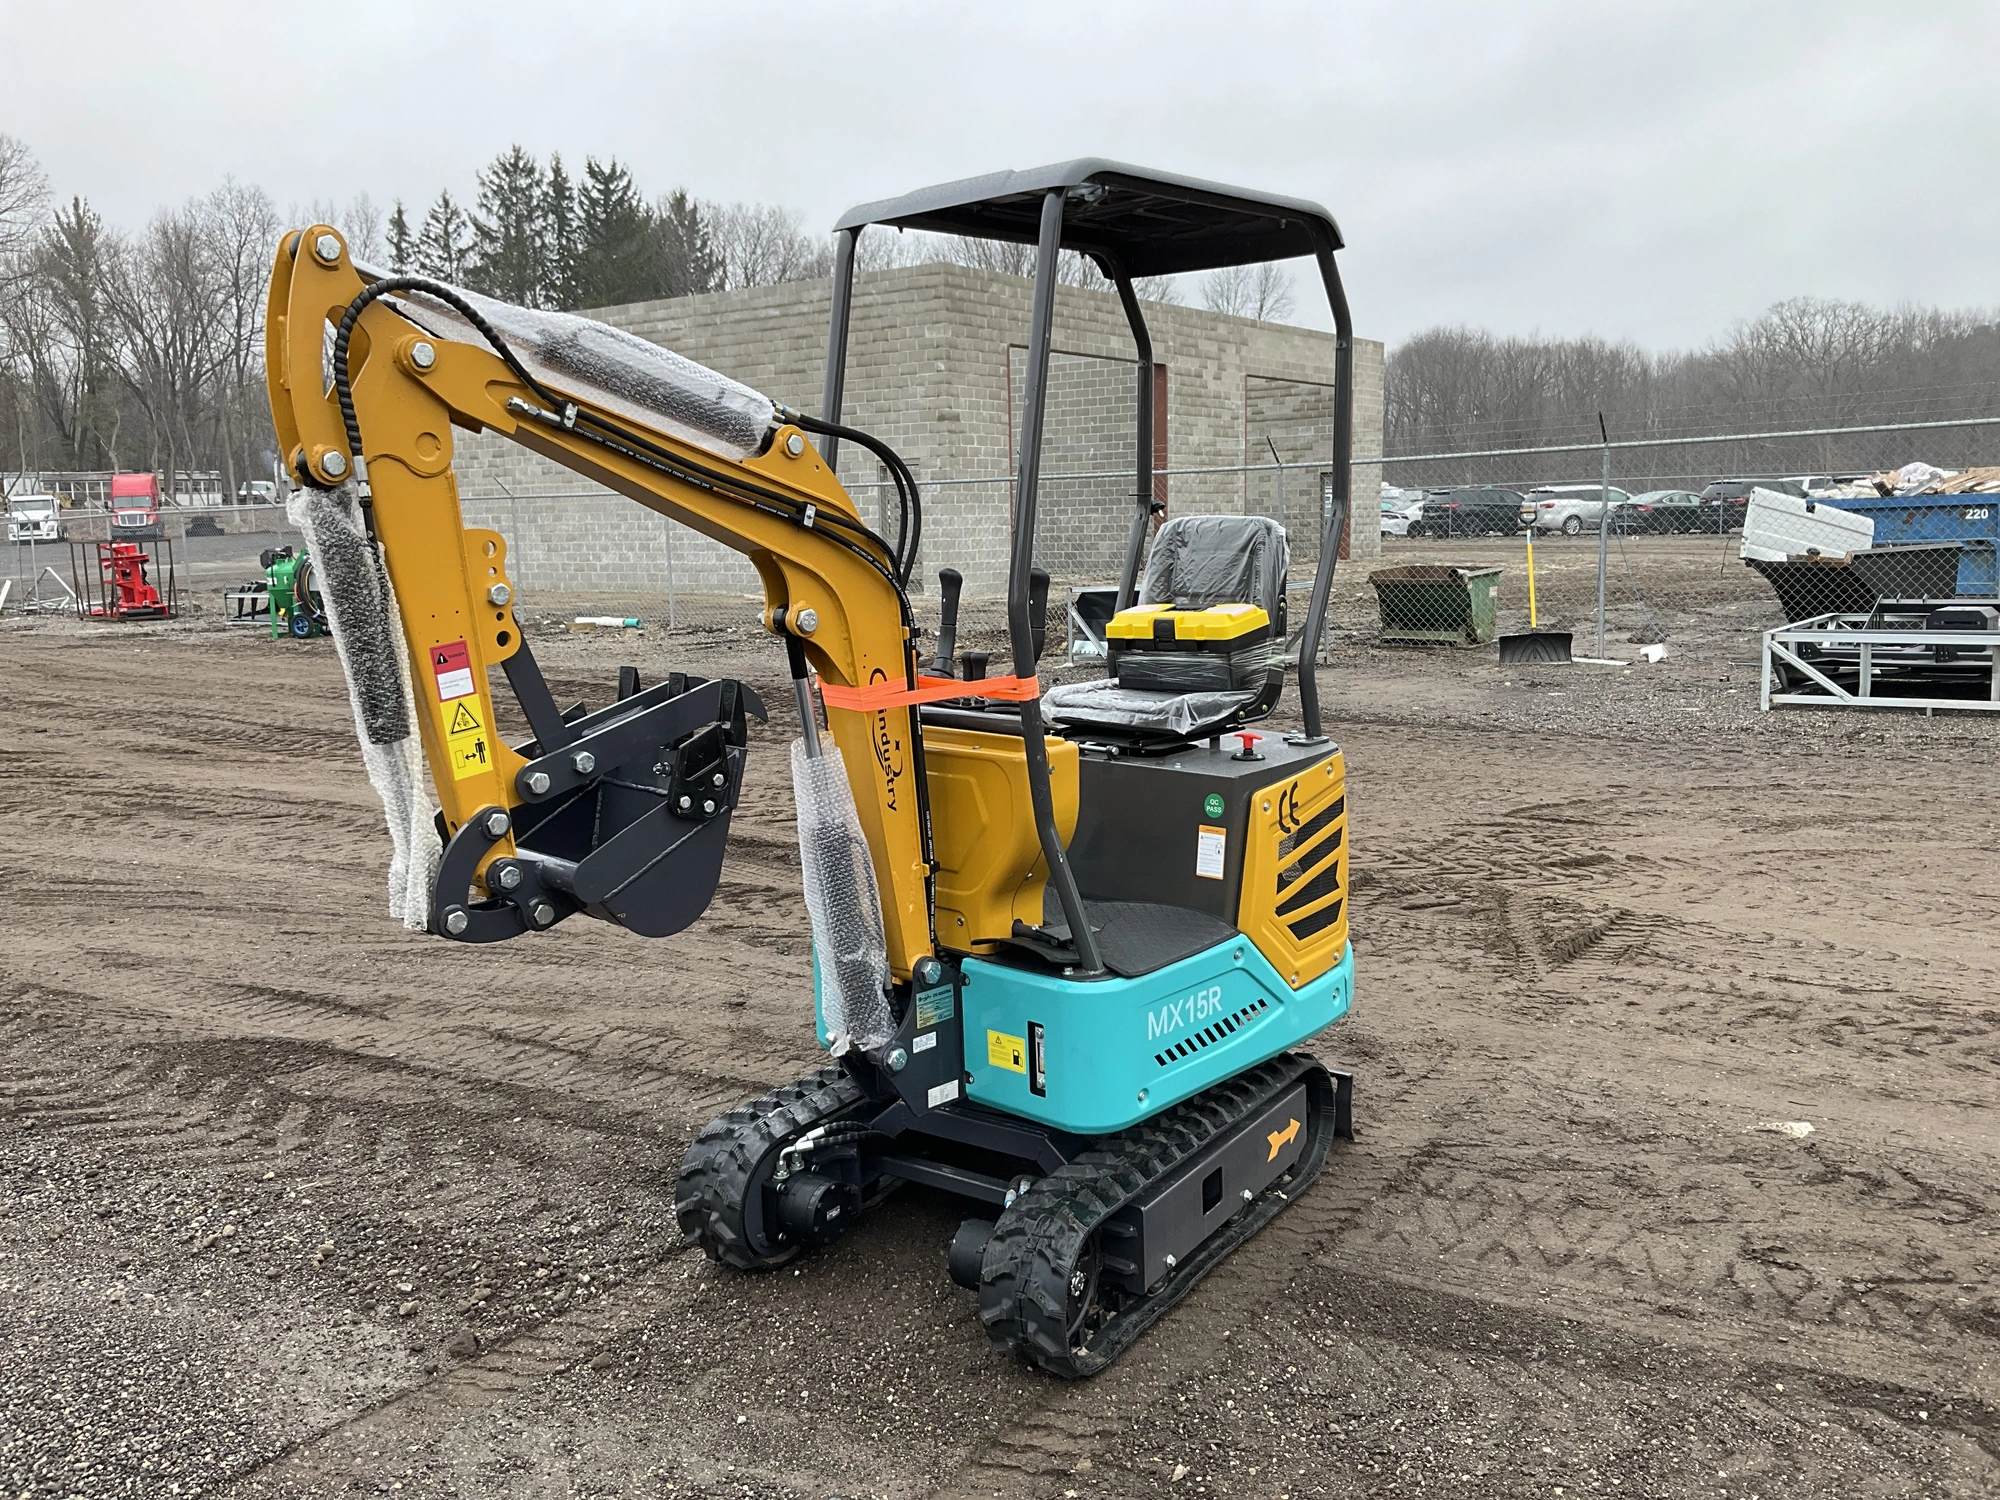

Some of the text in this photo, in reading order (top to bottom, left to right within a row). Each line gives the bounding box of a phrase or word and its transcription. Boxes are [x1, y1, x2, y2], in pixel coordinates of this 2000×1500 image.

[1965, 508, 1989, 520] 220
[1279, 780, 1300, 834] CE
[1148, 985, 1223, 1041] MX15R
